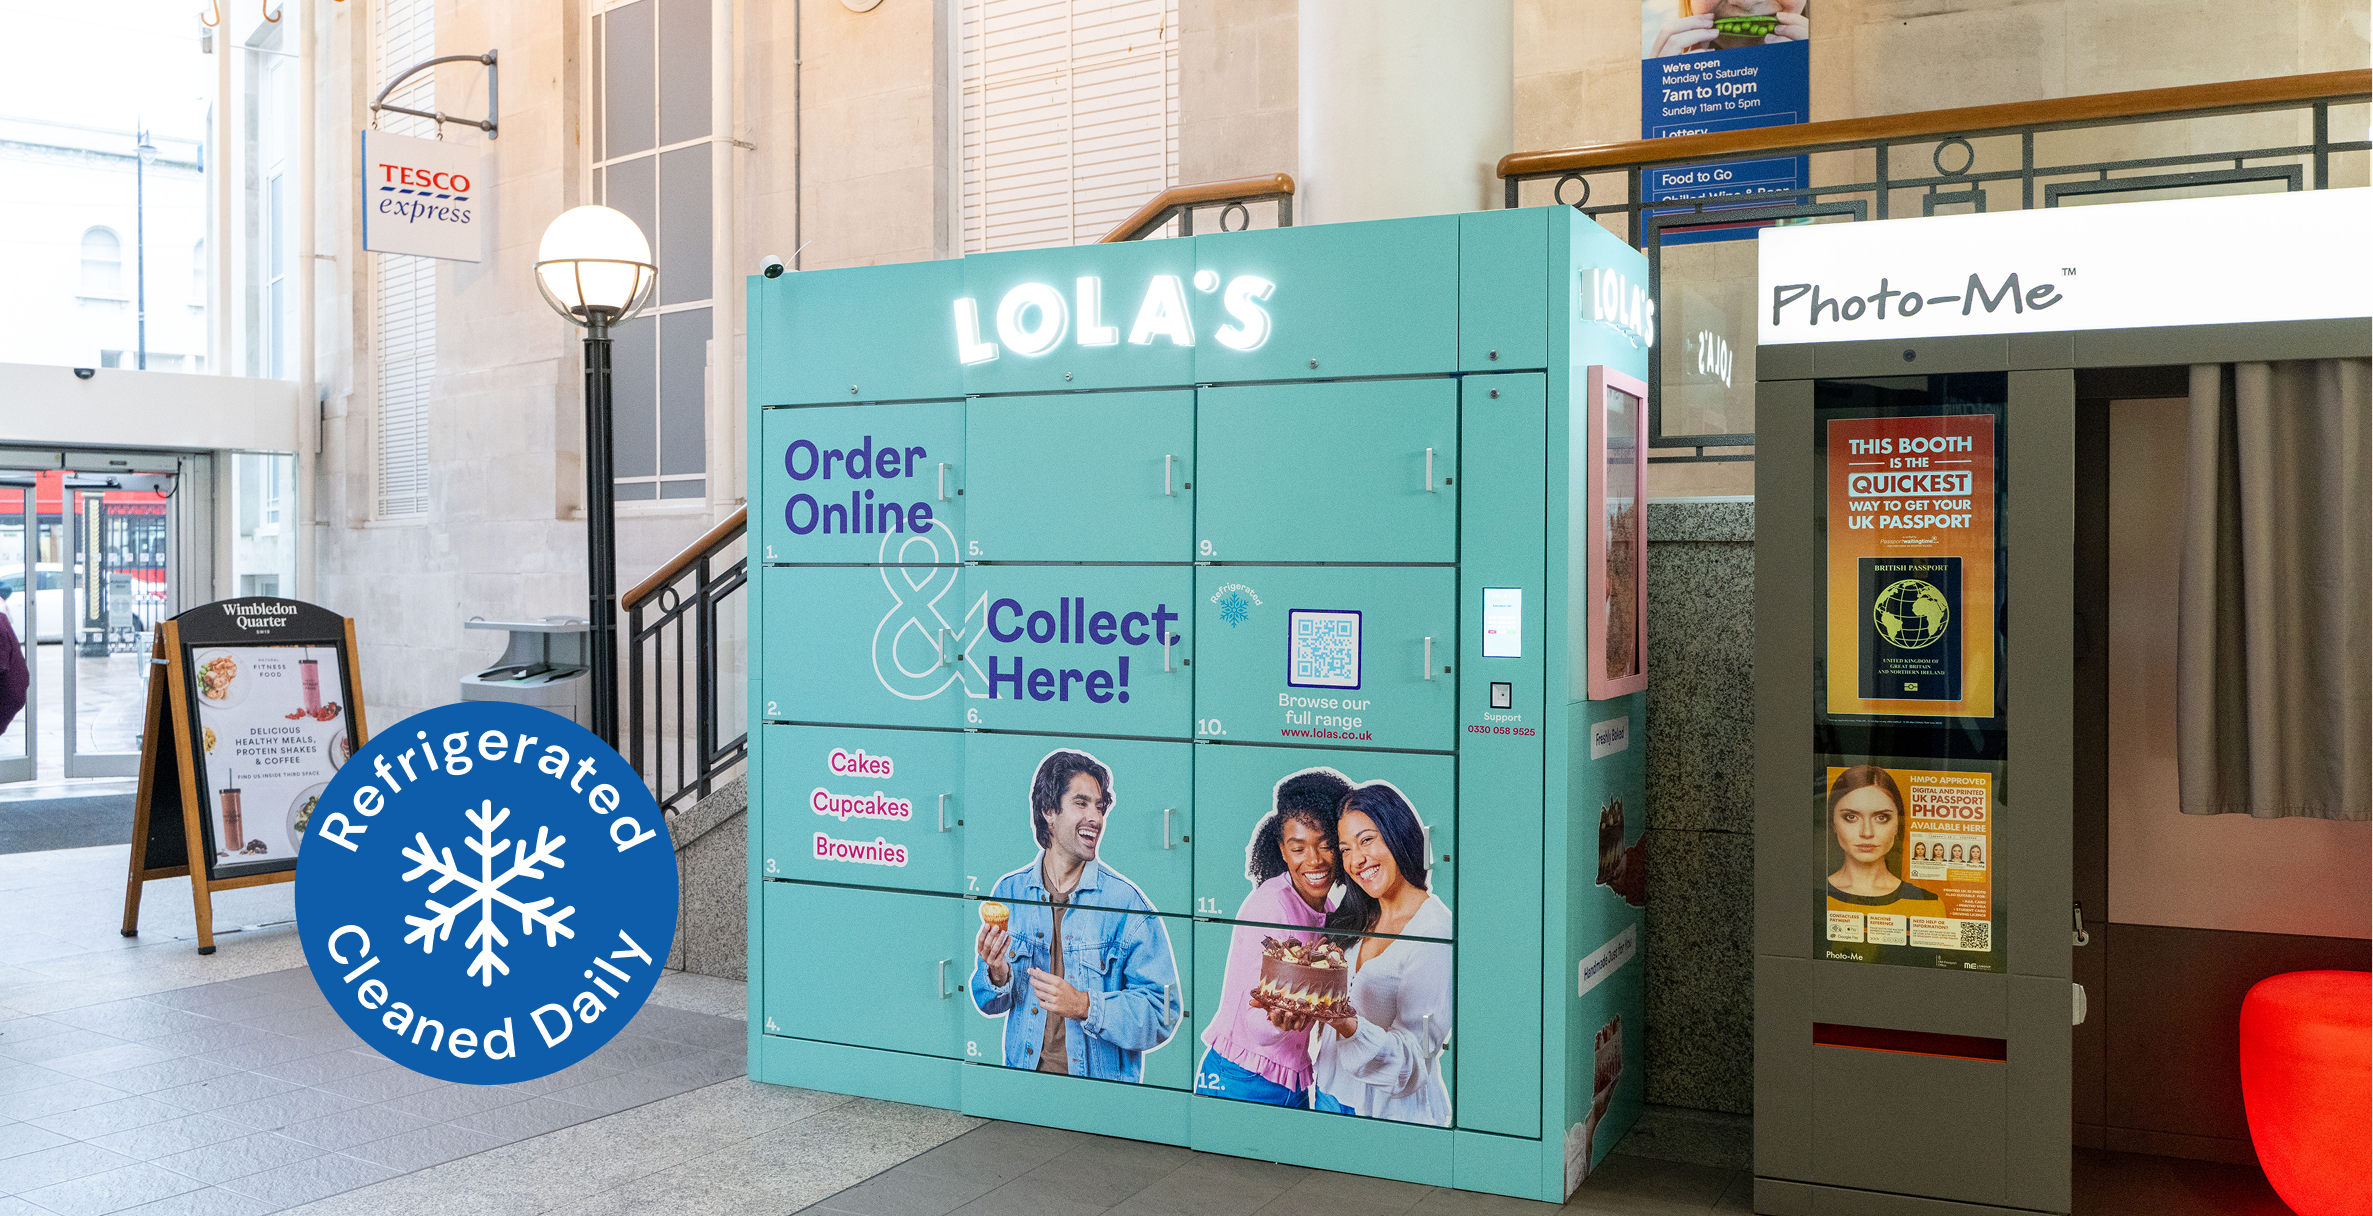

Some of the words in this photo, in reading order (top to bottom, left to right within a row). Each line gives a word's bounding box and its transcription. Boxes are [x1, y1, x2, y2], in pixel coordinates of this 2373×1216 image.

[1663, 62, 1691, 74] We're
[1694, 59, 1720, 71] open
[1662, 72, 1700, 85] Monday
[1702, 71, 1713, 80] to
[1716, 66, 1759, 79] Saturday
[1662, 89, 1693, 102] 7am
[1696, 86, 1712, 99] to
[1715, 82, 1757, 97] 10pm
[1662, 105, 1697, 117] Sunday
[1700, 103, 1722, 113] 11am
[1725, 101, 1736, 110] to
[1738, 99, 1761, 109] 5pm
[379, 164, 471, 193] TESCO
[1662, 172, 1694, 186] Food
[1697, 171, 1710, 182] to
[1714, 169, 1733, 180] Go
[379, 198, 472, 224] express
[1593, 267, 1655, 348] LOLA'S
[1773, 272, 2063, 326] Photo-Me
[953, 269, 1275, 366] LOLA'S
[1849, 438, 1893, 455] THIS
[1899, 436, 1972, 453] BOOTH
[784, 435, 927, 481] Order
[1890, 458, 1902, 468] IS
[1905, 457, 1929, 468] THE
[784, 489, 934, 535] Online
[1849, 501, 1880, 511] WAY
[1884, 501, 1901, 511] TO
[1905, 500, 1930, 510] GET
[1932, 499, 1971, 510] YOUR
[1849, 516, 1874, 529] UK
[1880, 514, 1972, 529] PASSPORT
[766, 545, 778, 559] 1.
[969, 541, 984, 556] 5.
[1200, 539, 1218, 557] 9.
[1210, 582, 1263, 607] Refrigerated
[222, 602, 298, 615] Wimbledon
[236, 616, 287, 630] Quarter
[987, 596, 1181, 646] Collect
[988, 655, 1130, 704] Here!
[768, 700, 782, 716] 2.
[1278, 693, 1338, 709] Browse
[1342, 698, 1371, 711] our
[967, 708, 983, 724] 6.
[1286, 710, 1311, 726] full
[1315, 714, 1362, 731] range
[1484, 712, 1522, 723] Support
[250, 727, 301, 736] DELICIOUS
[1198, 718, 1227, 736] 10.
[1281, 728, 1373, 741] www.lolas.co.uk
[1468, 725, 1491, 734] 0330
[1493, 726, 1511, 735] 058
[1512, 728, 1536, 736] 9525
[236, 738, 278, 746] HEALTHY
[282, 736, 317, 744] MEALS,
[1596, 730, 1611, 746] Freshly
[1612, 726, 1624, 741] Baked
[236, 748, 277, 756] PROTEIN
[280, 746, 317, 754] SHAKES
[264, 756, 301, 764] COFFEE
[831, 751, 890, 775] Cakes
[1910, 776, 1937, 784] HMPO
[1940, 777, 1986, 786] APPROVED
[812, 791, 910, 819] Cupcakes
[1912, 795, 1928, 803] UK
[1930, 795, 1984, 805] PASSPORT
[1912, 804, 1984, 820] PHOTOS
[1910, 822, 1960, 831] AVAILABLE
[1962, 824, 1986, 833] HERE
[816, 836, 906, 864] Brownies
[766, 858, 781, 874] 3.
[967, 876, 980, 892] 7.
[1198, 897, 1223, 915] 11.
[1826, 951, 1863, 961] Photo-Me
[766, 1017, 781, 1032] 4.
[966, 1040, 983, 1057] 8.
[1198, 1072, 1226, 1091] 12.
